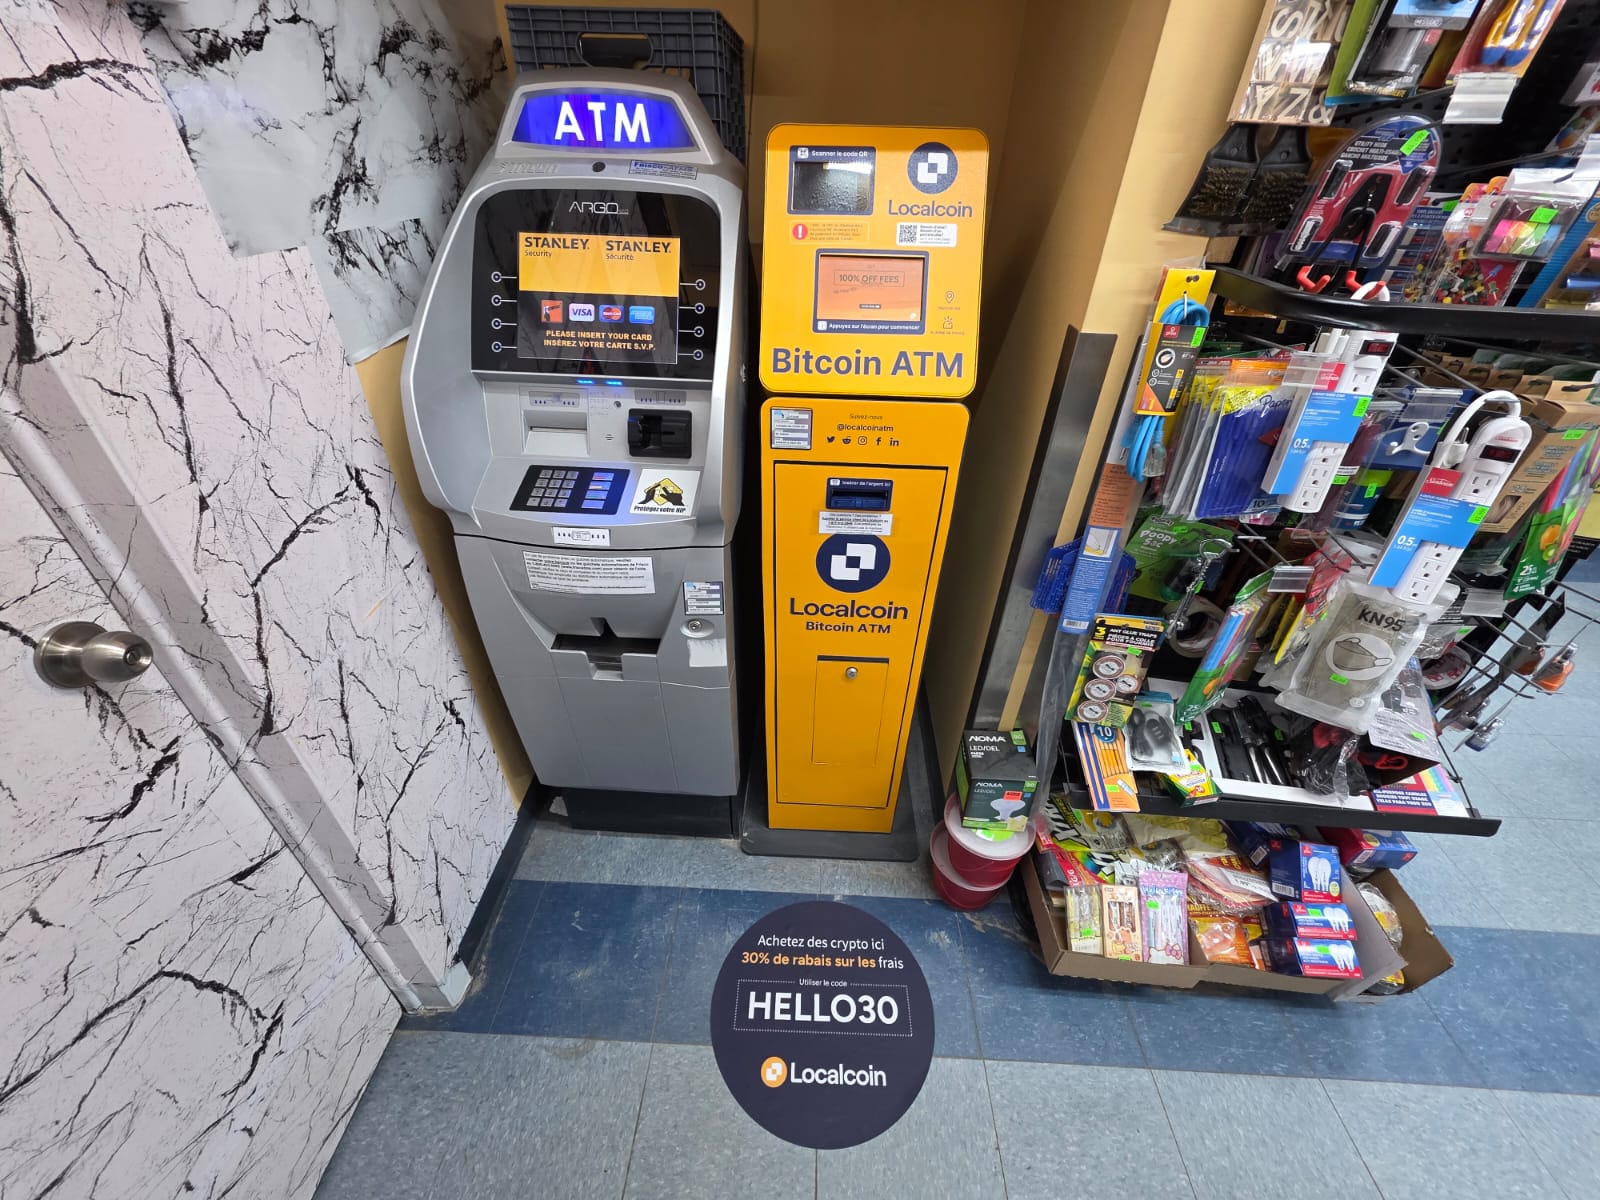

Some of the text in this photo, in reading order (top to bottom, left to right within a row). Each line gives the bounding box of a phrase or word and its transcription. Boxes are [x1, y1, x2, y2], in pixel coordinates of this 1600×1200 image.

[554, 101, 651, 143] ATM
[568, 201, 619, 214] ARGO
[888, 200, 973, 218] Localcoin
[524, 236, 671, 254] STANLEY STANLEY
[524, 250, 552, 258] Security
[839, 274, 859, 282] 100%
[880, 275, 899, 283] FEES
[572, 308, 593, 317] VISA
[546, 330, 652, 341] PLEASE INSERT YOUR CARD
[543, 338, 577, 347] INSÉREZ
[606, 342, 632, 350] CARTE
[633, 343, 656, 351] S.V.P.
[772, 347, 963, 378] Bitcoin ATM
[837, 423, 894, 432] @localcoinatm
[1140, 530, 1178, 545] Poopy
[1143, 538, 1164, 548] Sac
[789, 597, 909, 620] Localcoin
[805, 621, 891, 634] Bitcoin ATM
[1358, 608, 1406, 632] KN95
[1097, 726, 1113, 737] 10
[757, 935, 885, 951] Achetez des crypto ici
[741, 952, 904, 969] 30% de rabais sur les frais
[748, 991, 899, 1025] HELLO30
[790, 1062, 887, 1087] Localcoin
